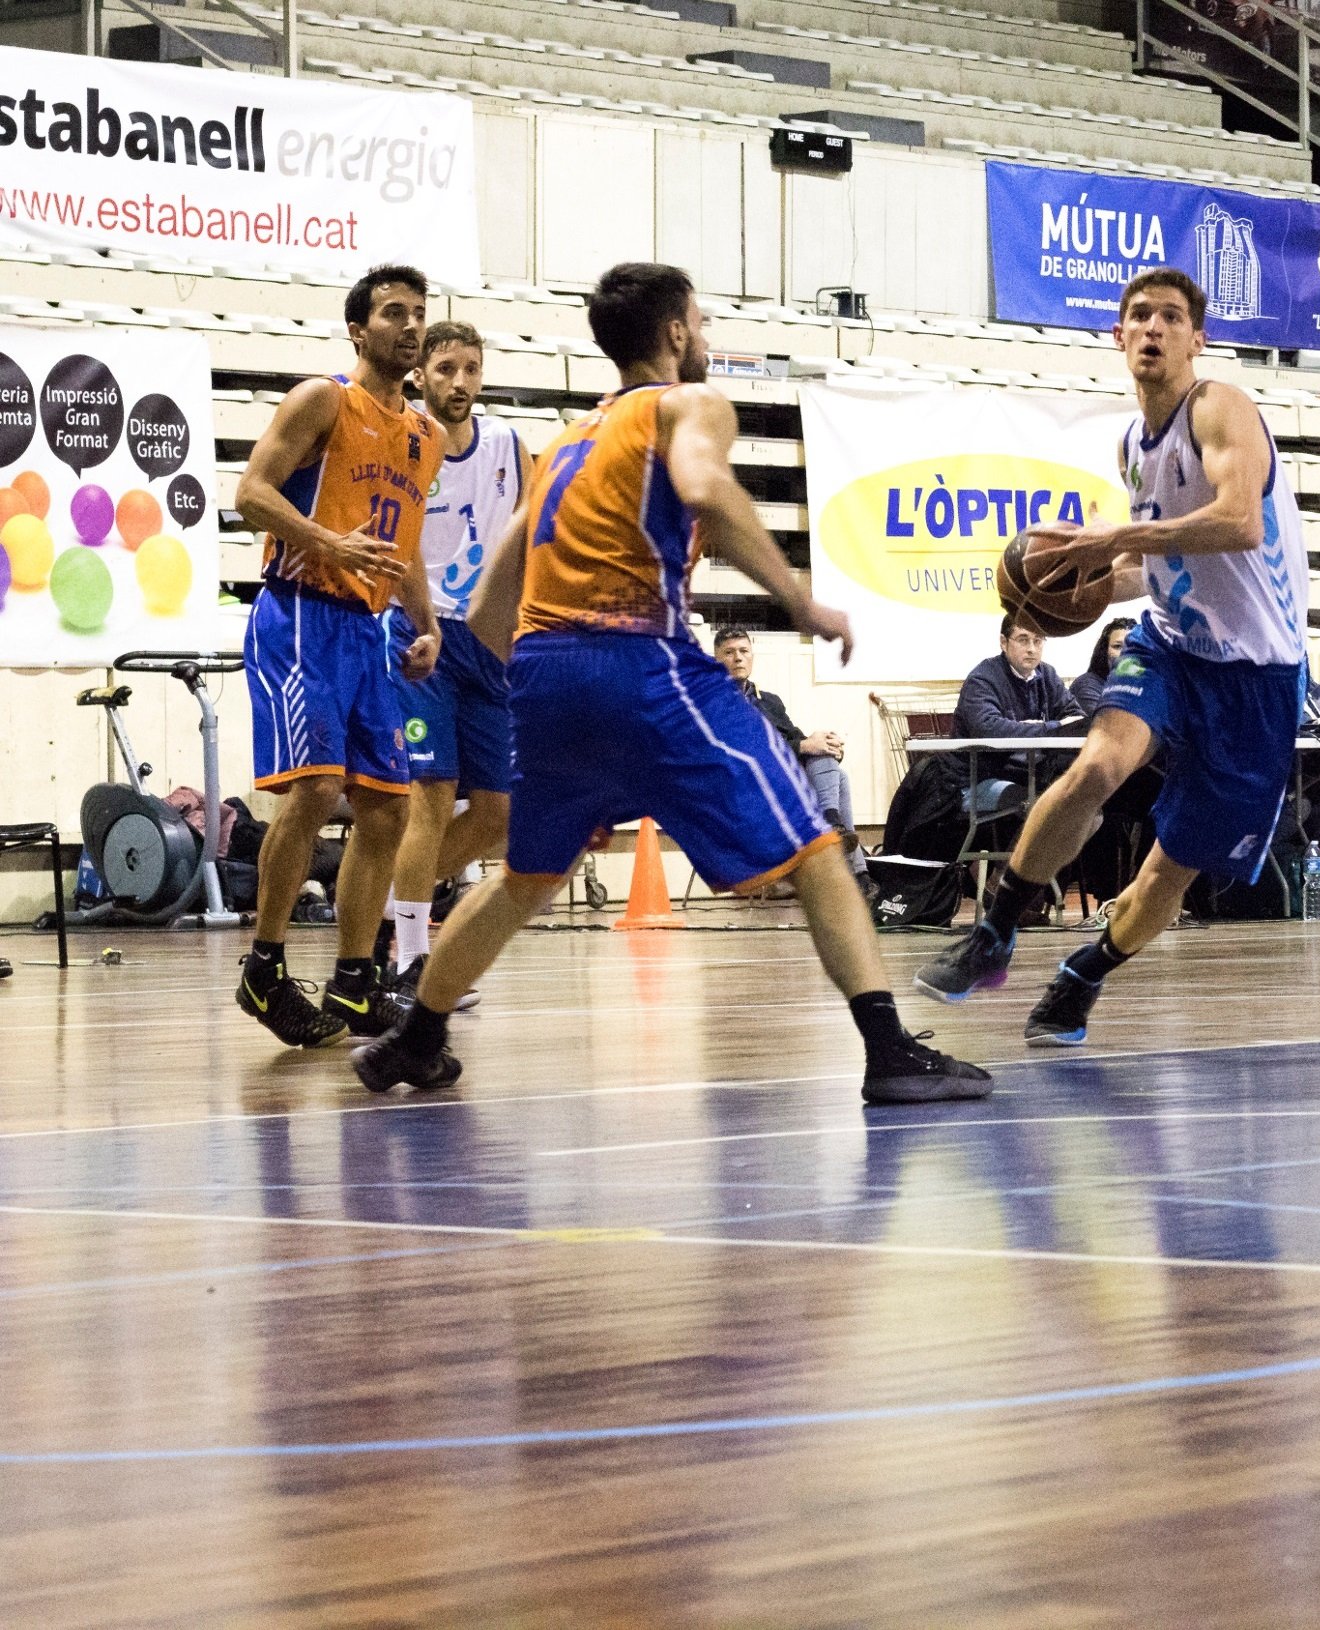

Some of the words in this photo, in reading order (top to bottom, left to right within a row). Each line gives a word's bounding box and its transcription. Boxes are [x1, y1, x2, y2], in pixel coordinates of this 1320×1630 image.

[788, 132, 804, 142] HOME
[826, 137, 844, 148] GUEST
[1041, 193, 1166, 262] MÚTUA
[1040, 255, 1063, 278] DE
[0, 386, 29, 403] eria
[46, 384, 118, 406] Impressió
[65, 407, 100, 427] Gran
[56, 430, 108, 449] Format
[130, 418, 186, 441] Disseny
[136, 438, 182, 460] Gràfic
[174, 491, 199, 510] Etc.
[533, 438, 597, 548] 7
[886, 473, 1084, 539] L'ÒPTICA
[367, 492, 401, 543] 10
